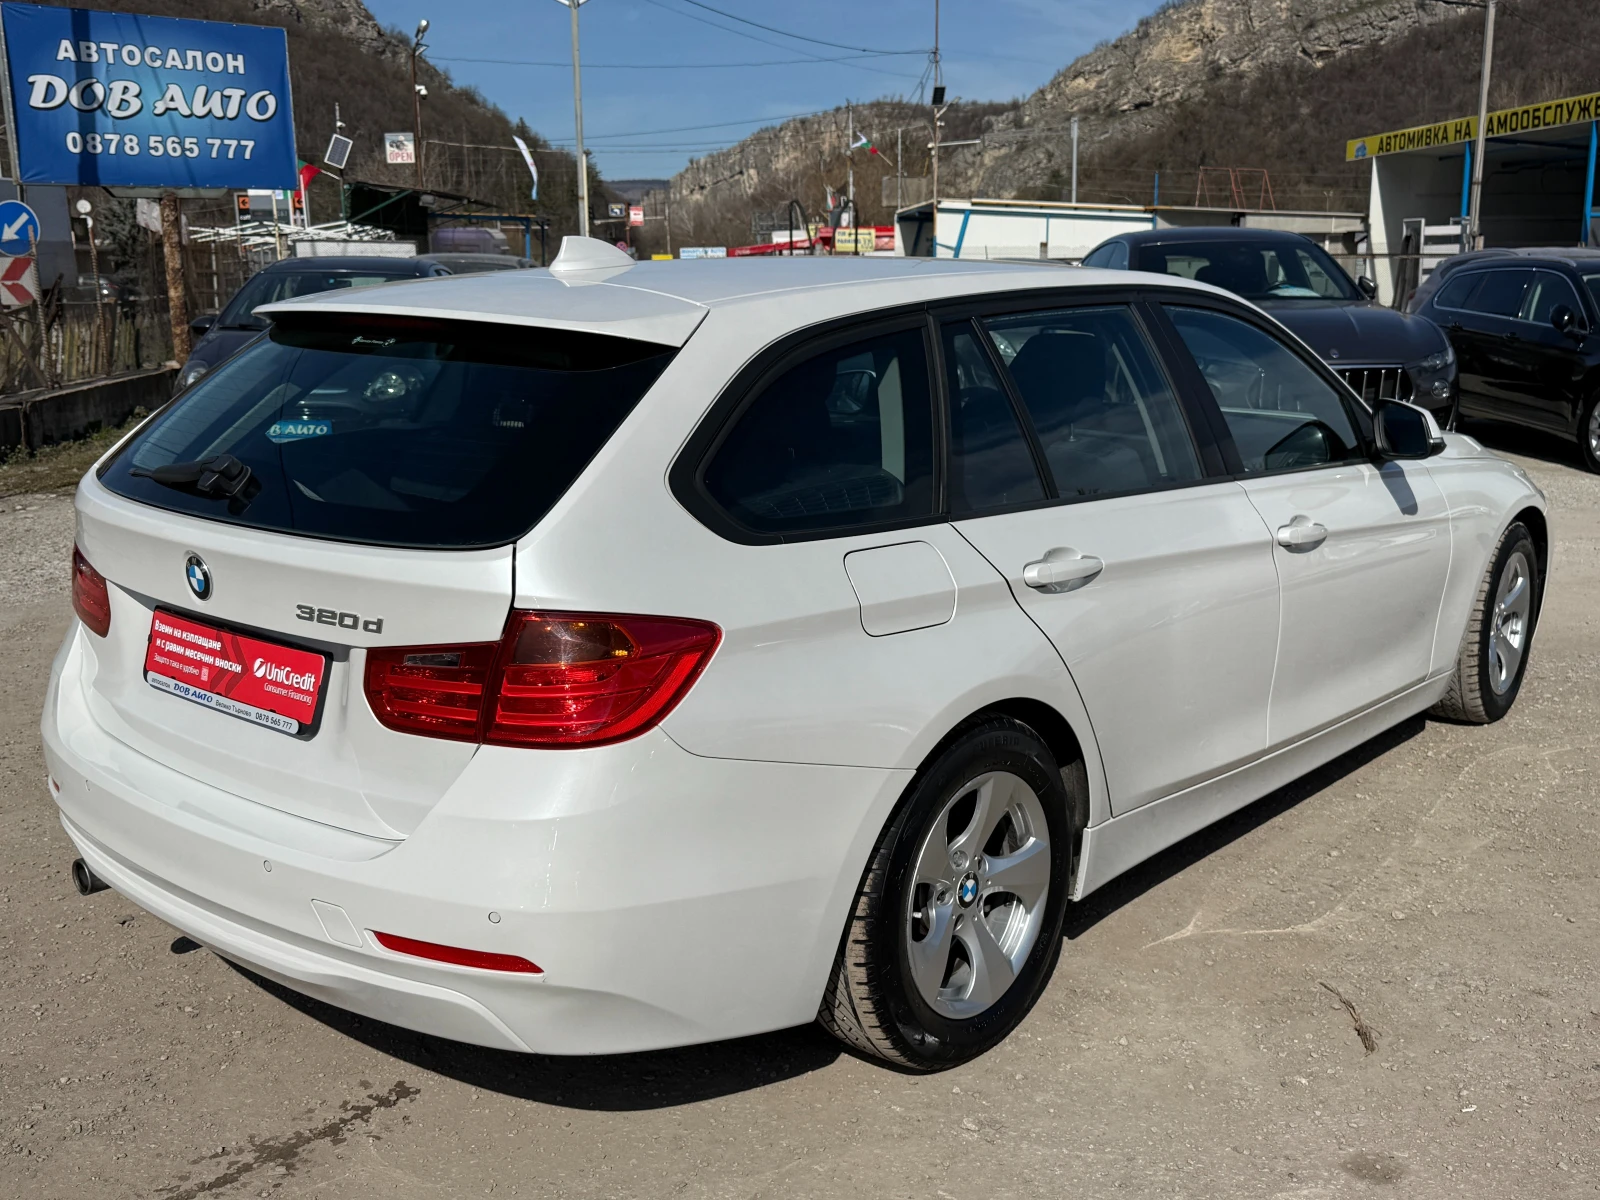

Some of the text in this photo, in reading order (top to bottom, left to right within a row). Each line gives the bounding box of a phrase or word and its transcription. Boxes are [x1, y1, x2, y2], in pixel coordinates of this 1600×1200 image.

[56, 39, 246, 75] АВТОСАЛОН
[27, 74, 278, 121] DOB AUTO
[1377, 96, 1600, 154] АВТОМИВКА НА АМООБСЛУЖ
[65, 131, 256, 160] 0878 565 777
[389, 151, 413, 162] OPEN
[285, 424, 328, 435] AUTO
[154, 619, 222, 651] Вземи на изплащане
[156, 638, 242, 674] и с равни месечни вноски
[169, 659, 179, 669] така
[266, 662, 316, 691] UniCredit
[173, 683, 213, 703] DOB AUTO
[264, 683, 313, 706] Consumer Financing
[232, 704, 252, 717] Търново
[255, 711, 293, 730] 0878 565 777
